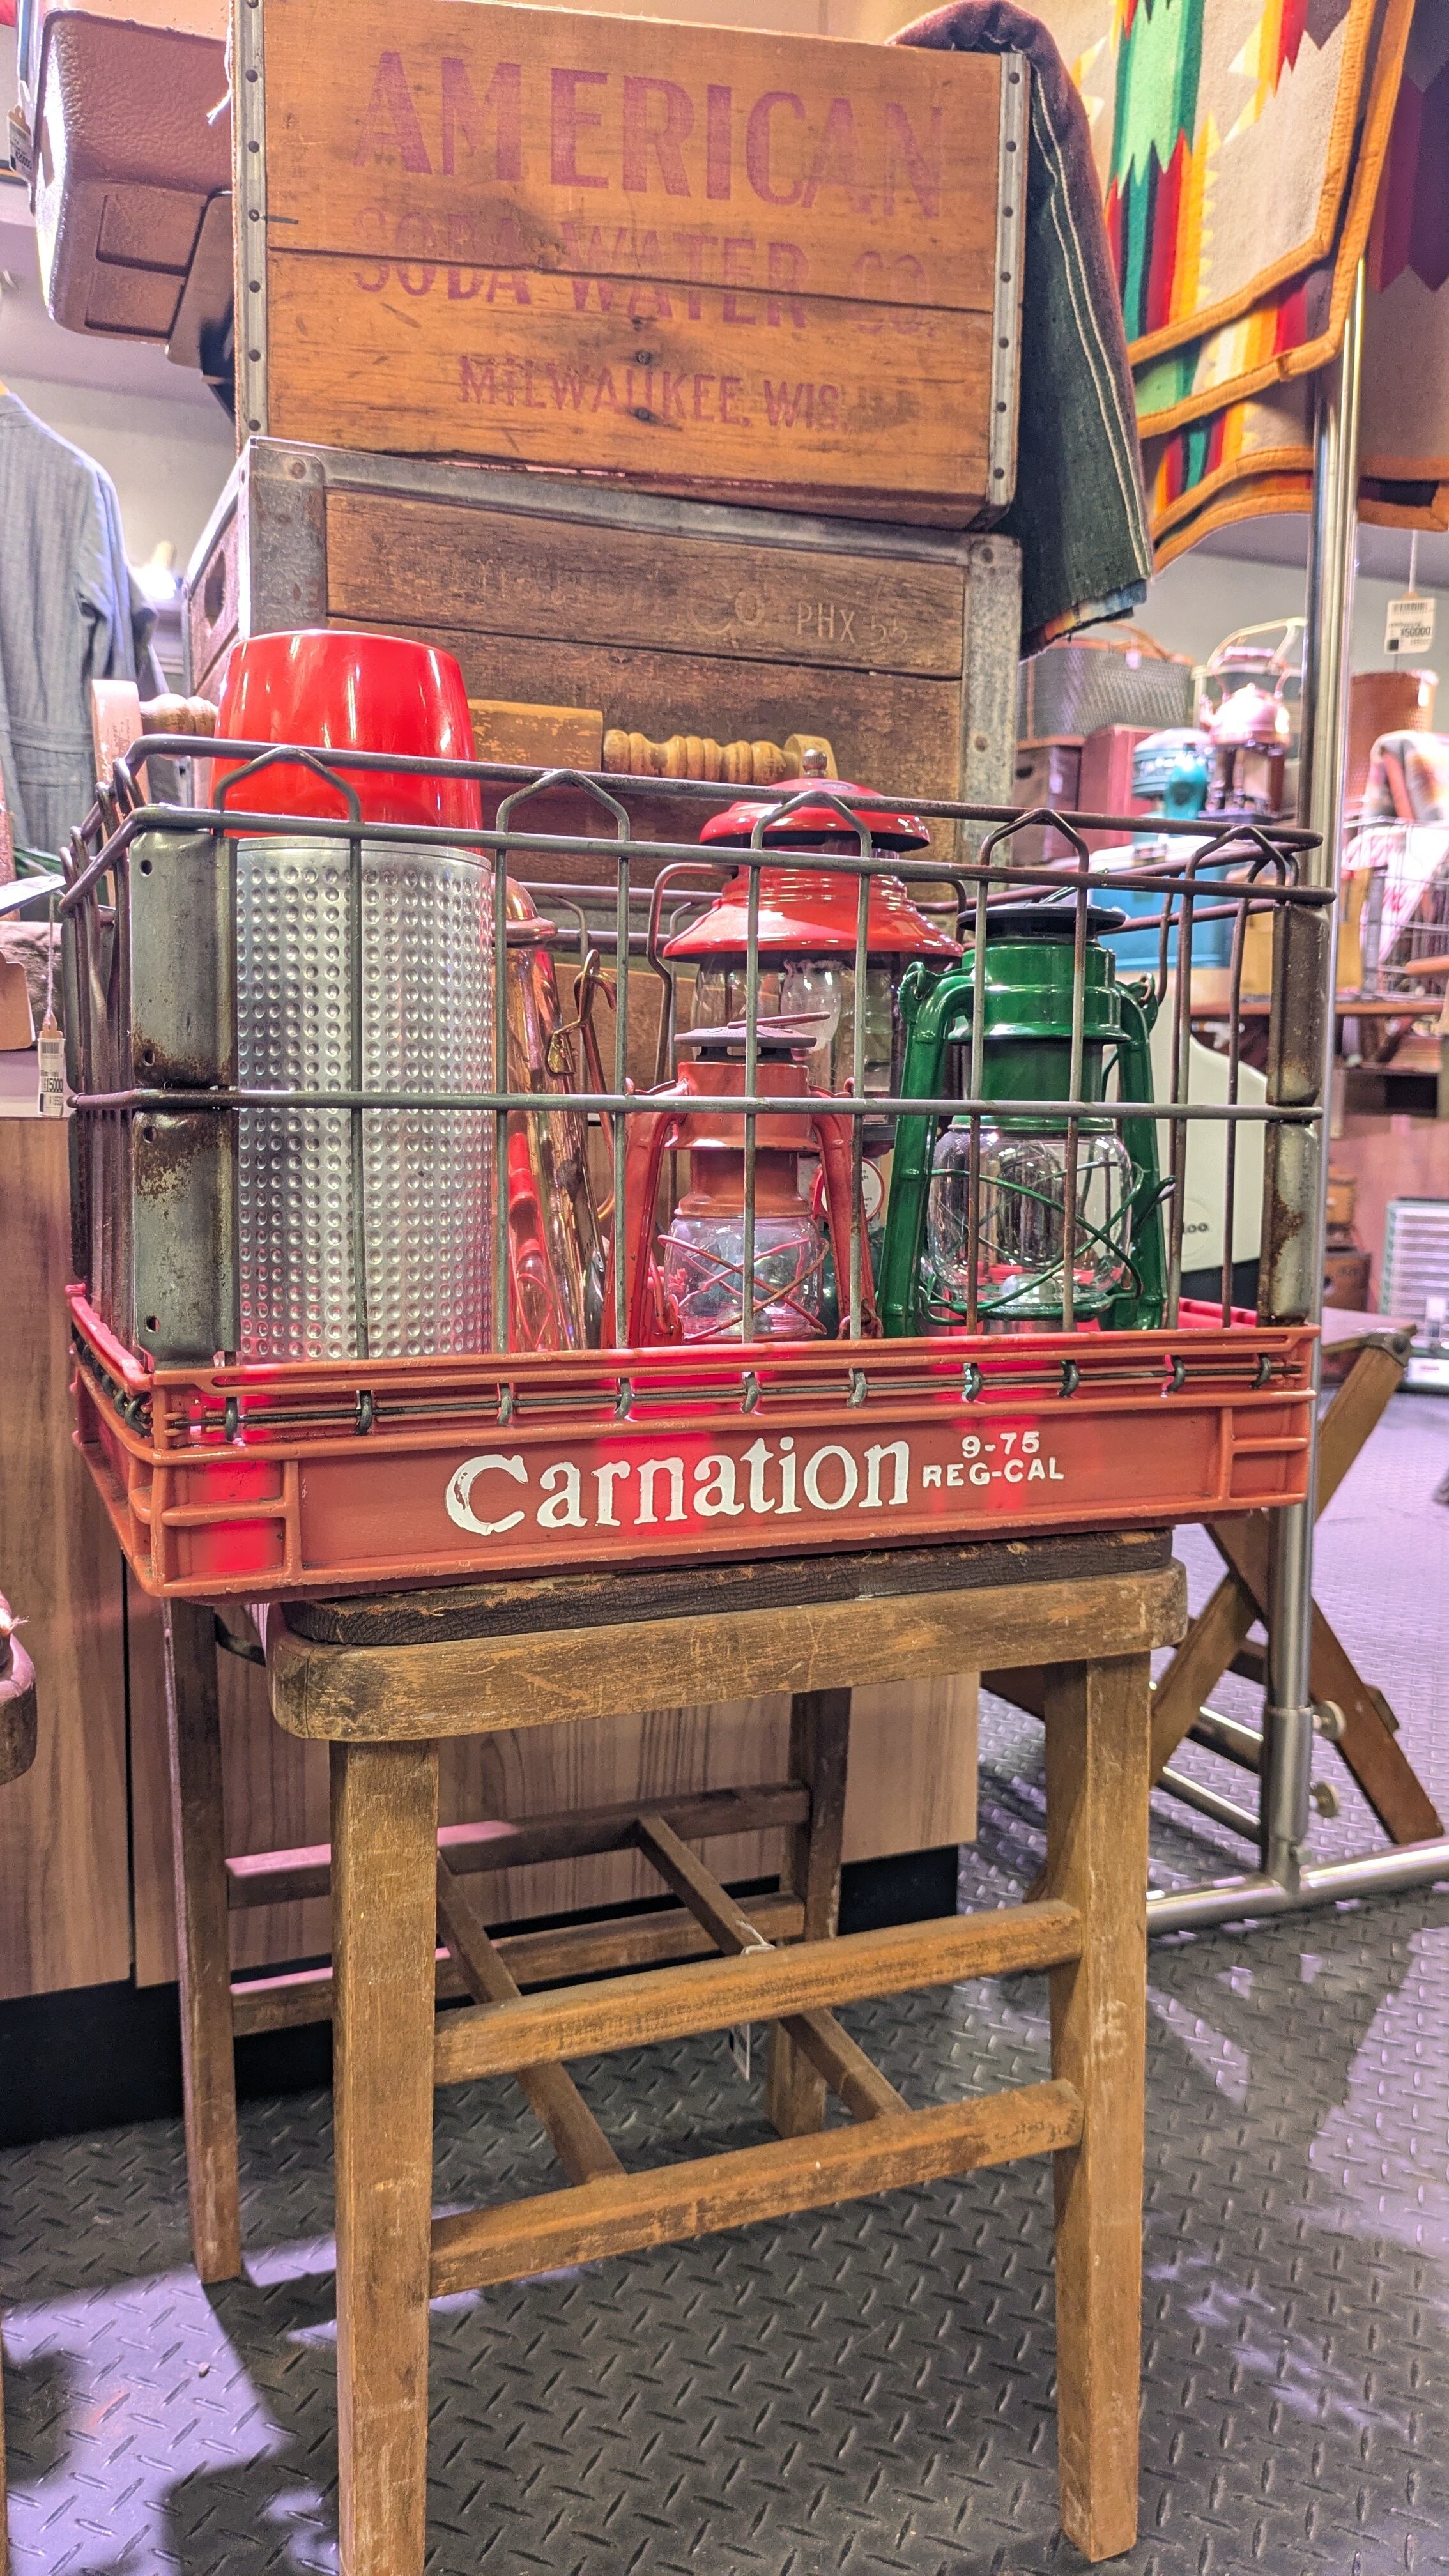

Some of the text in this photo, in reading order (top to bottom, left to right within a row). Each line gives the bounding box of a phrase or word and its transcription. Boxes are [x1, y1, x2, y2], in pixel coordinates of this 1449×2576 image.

[353, 51, 943, 222] AMERICAN
[353, 206, 938, 341] SODA WATER CO.
[797, 599, 854, 643] PHX
[922, 1457, 1064, 1489] REG-CAL
[962, 1432, 1040, 1458] 9-75
[445, 1436, 910, 1536] Carnation
